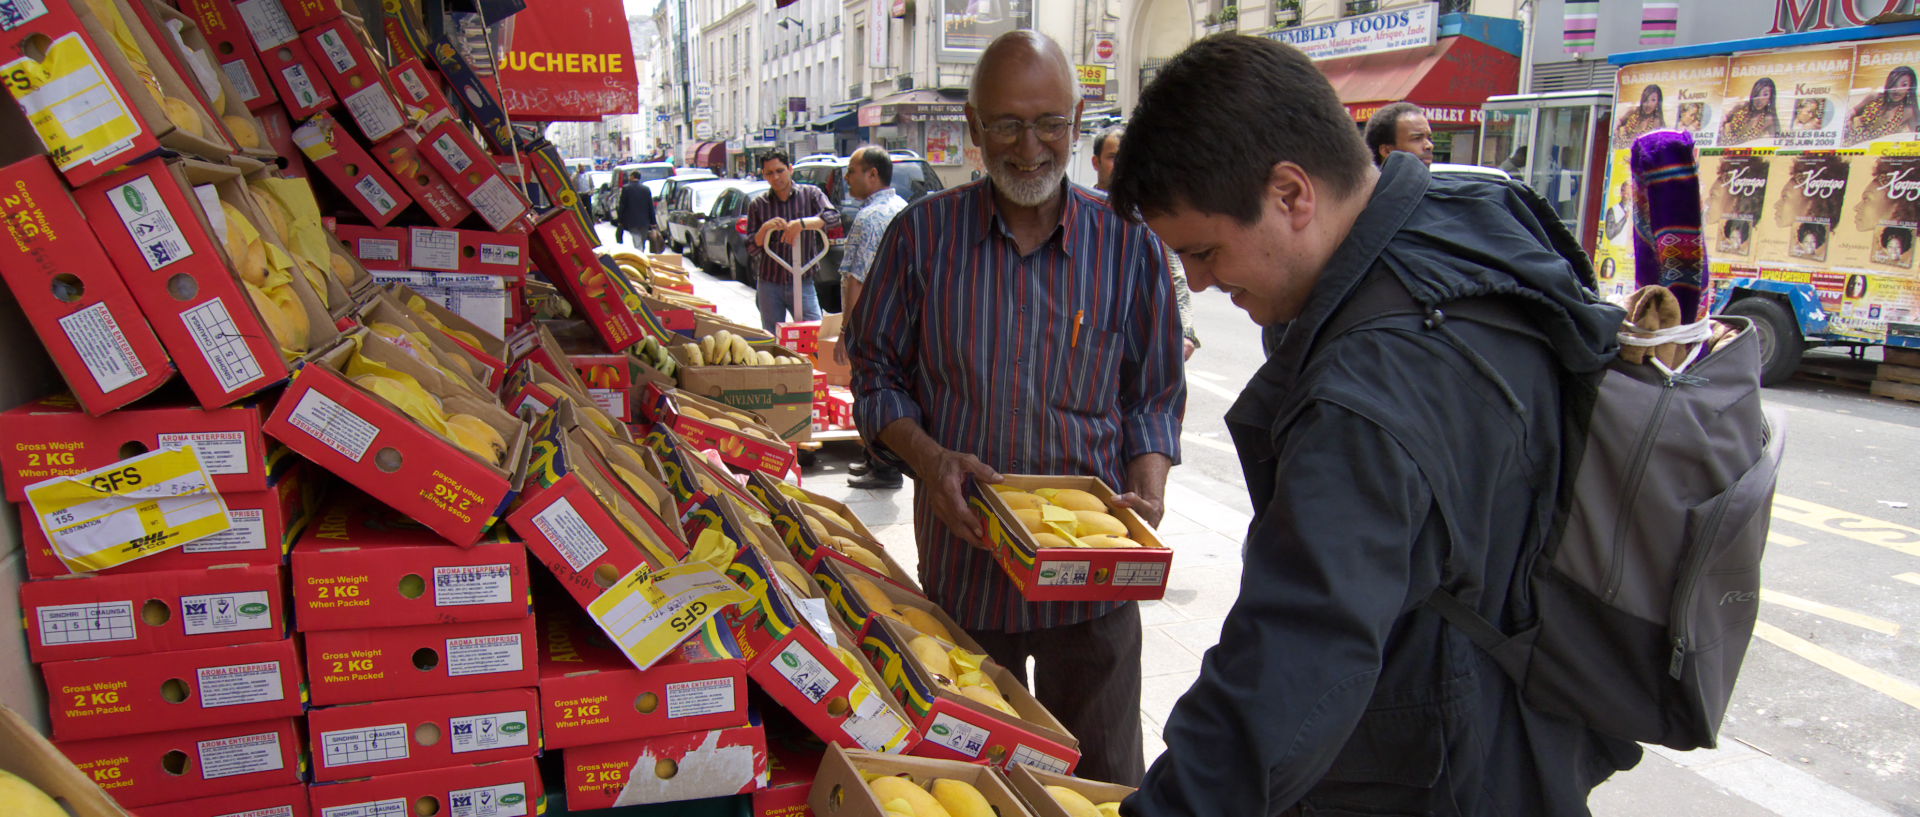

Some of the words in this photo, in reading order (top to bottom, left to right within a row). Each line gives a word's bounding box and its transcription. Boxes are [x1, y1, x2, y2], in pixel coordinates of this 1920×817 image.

[205, 12, 219, 28] KG
[1351, 11, 1410, 36] FOODS
[1376, 29, 1406, 42] Afrique,
[1407, 26, 1425, 36] Inde
[1622, 71, 1678, 85] BARBARA
[1679, 65, 1725, 81] KANAM
[1731, 62, 1794, 78] BARBARA
[1801, 59, 1849, 73] KANAM
[1795, 83, 1831, 96] KARIBU
[1774, 139, 1784, 147] LE
[1815, 138, 1835, 147] 2009
[1775, 131, 1796, 140] DANS
[1796, 131, 1813, 139] LES
[1813, 131, 1837, 139] BACS
[15, 180, 37, 210] Gross
[32, 207, 58, 242] Weight
[424, 192, 451, 223] Pakistan
[4, 194, 20, 208] 2
[17, 209, 40, 239] KG
[191, 315, 214, 348] CHAUNSA
[97, 305, 116, 333] AROMA
[112, 330, 145, 376] ENTERPRISES
[214, 354, 234, 382] SINDHRI
[723, 393, 773, 404] PLANTAIN
[191, 432, 242, 441] ENTERPRISES
[292, 417, 335, 448] ENTERPRISES
[16, 443, 46, 451] Gross
[47, 440, 84, 452] Weight
[336, 440, 360, 461] AROMA
[28, 453, 41, 467] 2
[46, 452, 75, 466] KG
[18, 468, 49, 478] When
[50, 467, 88, 477] Packed
[91, 466, 142, 494] GFS
[432, 470, 463, 491] Packed
[433, 483, 461, 504] KG
[462, 489, 485, 505] When
[419, 488, 449, 514] Weight
[457, 498, 470, 511] 2
[54, 513, 75, 525] 155
[448, 504, 471, 523] Gross
[59, 518, 102, 537] DESTINATION
[536, 516, 567, 552] ENTERPRISES
[129, 531, 169, 550] DHL
[563, 549, 584, 572] AROMA
[462, 565, 510, 574] ENTERPRISES
[308, 577, 335, 585] Gross
[336, 575, 369, 585] Weight
[318, 587, 329, 599] 2
[334, 586, 360, 598] KG
[338, 599, 370, 607] Packed
[48, 611, 79, 619] SINDHRI
[90, 607, 127, 617] CHAUNSA
[671, 602, 707, 633] GFS
[51, 622, 59, 630] 4
[72, 622, 80, 630] 5
[449, 639, 473, 647] AROMA
[474, 635, 519, 645] ENTERPRISES
[736, 623, 759, 660] AROMA
[322, 651, 349, 660] Gross
[350, 649, 383, 659] Weight
[200, 668, 227, 677] AROMA
[228, 663, 278, 674] ENTERPRISES
[332, 662, 344, 673] 2
[348, 659, 374, 672] KG
[324, 675, 350, 683] When
[351, 672, 384, 681] Packed
[691, 678, 732, 688] ENTERPRISES
[62, 684, 92, 694] Gross
[93, 680, 129, 693] Weight
[75, 694, 87, 707] 2
[92, 692, 119, 706] KG
[555, 700, 580, 708] Gross
[580, 695, 609, 706] Weight
[65, 708, 95, 718] When
[96, 704, 132, 716] Packed
[563, 708, 574, 719] 2
[577, 704, 601, 718] KG
[556, 720, 580, 729] When
[580, 716, 610, 727] Packed
[201, 740, 227, 749] AROMA
[228, 732, 277, 746] ENTERPRISES
[332, 735, 359, 743] SINDHRI
[334, 745, 341, 753] 4
[352, 744, 359, 752] 5
[96, 756, 130, 768] Weight
[577, 765, 601, 773] Gross
[601, 761, 630, 771] Weight
[95, 768, 122, 782] KG
[586, 772, 596, 783] 2
[599, 769, 623, 782] KG
[578, 784, 601, 793] When
